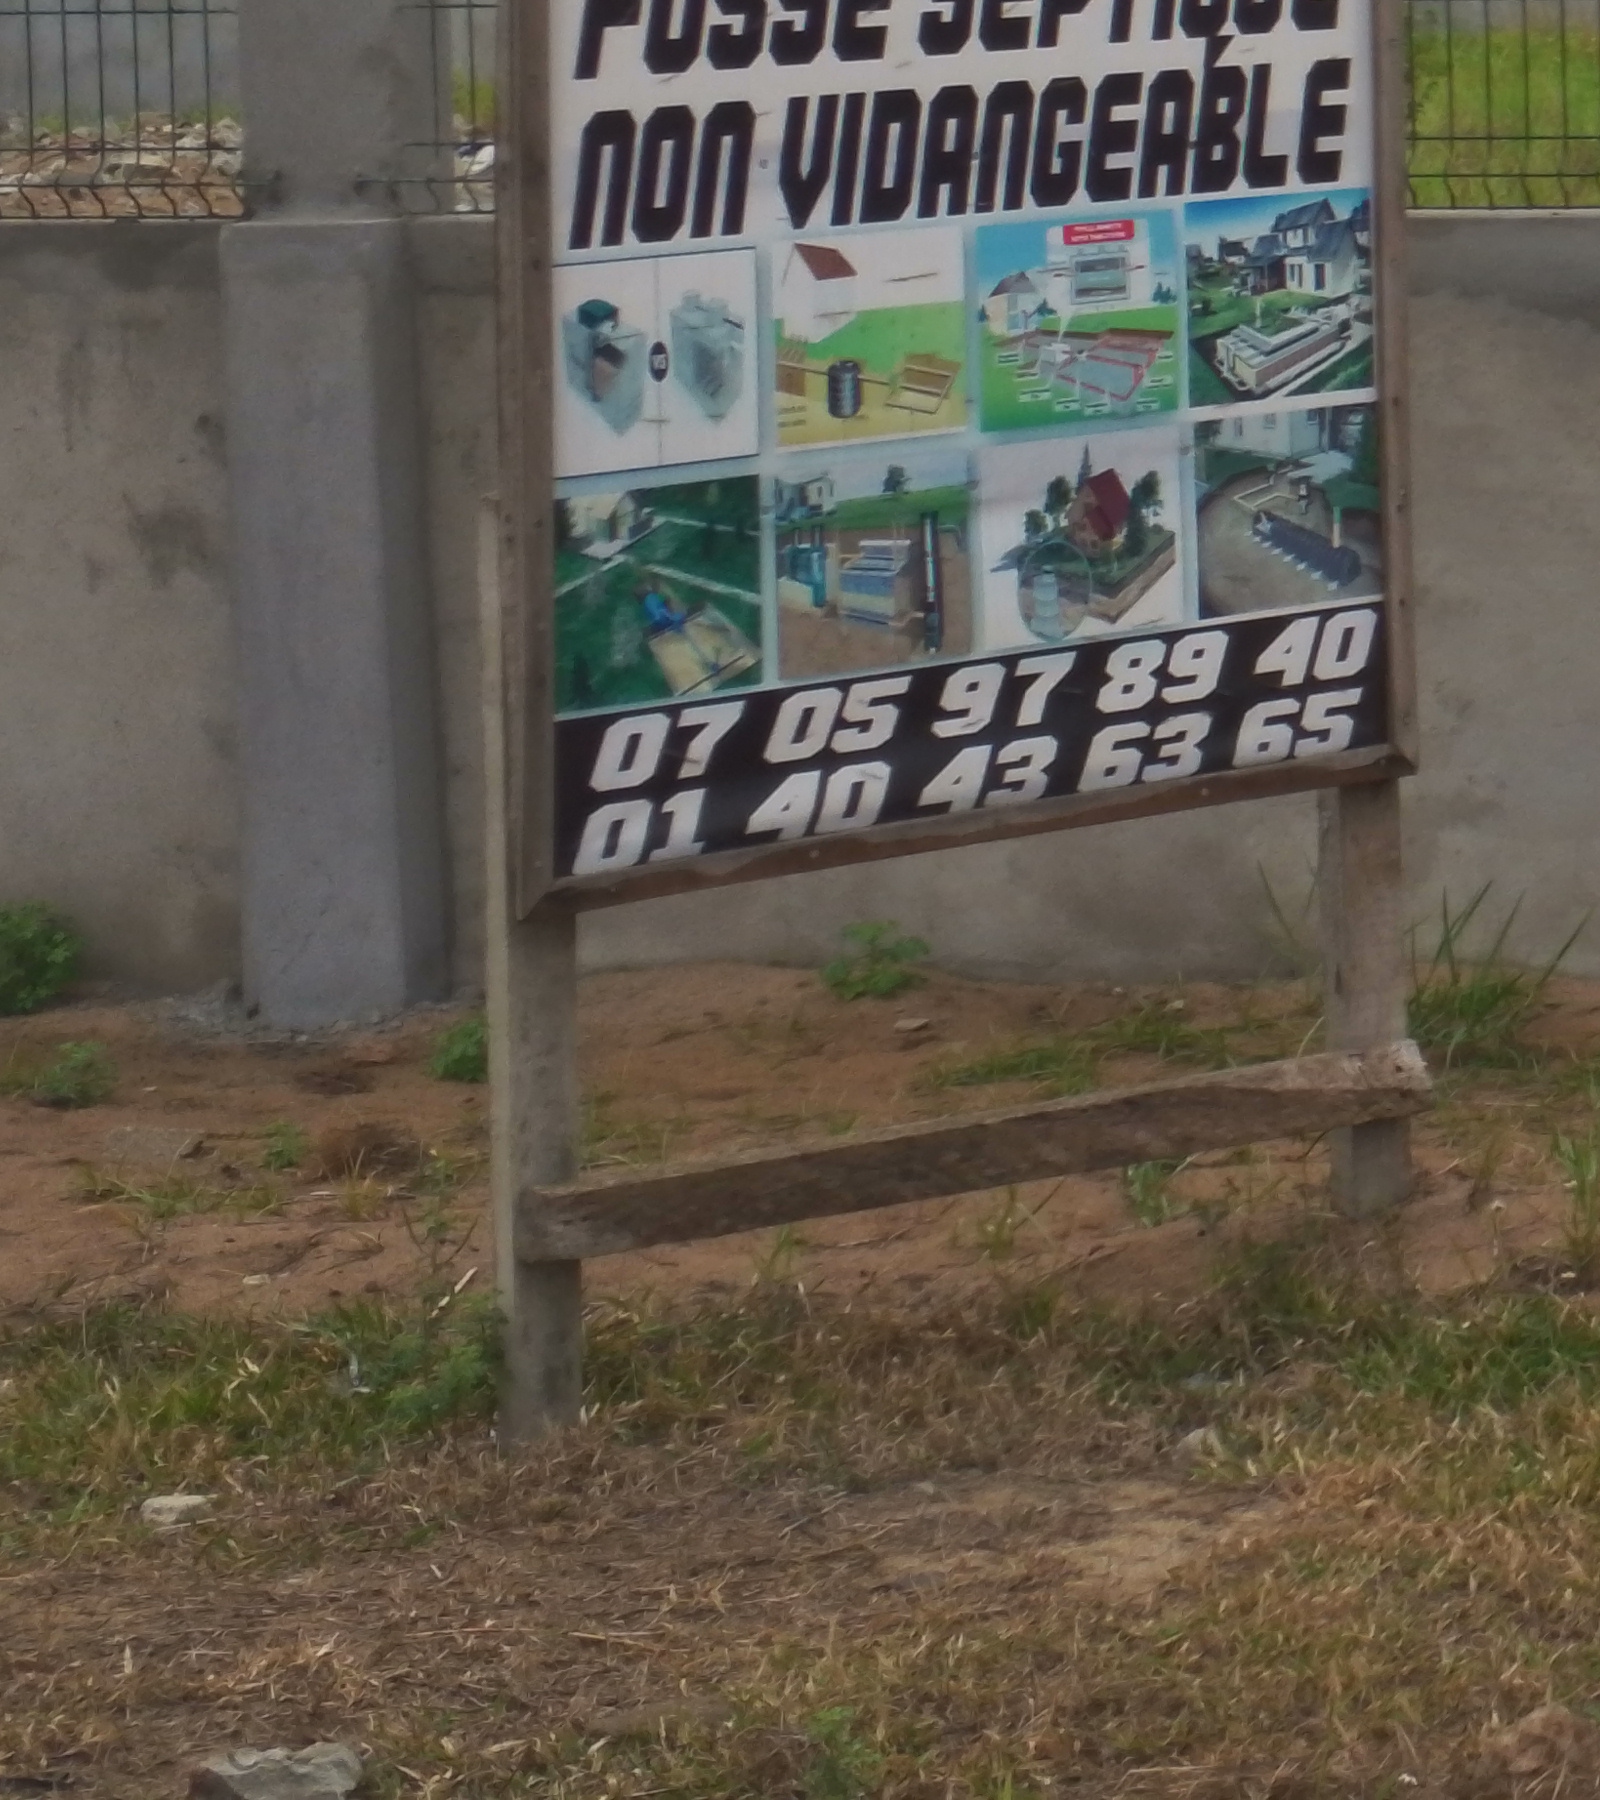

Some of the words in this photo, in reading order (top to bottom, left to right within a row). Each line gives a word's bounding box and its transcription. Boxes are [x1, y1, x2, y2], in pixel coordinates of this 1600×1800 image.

[568, 100, 757, 250] NON
[777, 57, 1351, 230] VIDANGEABLE
[571, 787, 709, 875] 01
[744, 761, 892, 840] 40
[917, 735, 1059, 813] 43
[1076, 711, 1214, 794] 63
[1231, 687, 1363, 768] 65
[589, 701, 745, 793] 07
[763, 675, 912, 764] 05
[931, 651, 1079, 739] 97
[1096, 630, 1231, 714] 89
[1255, 608, 1379, 687] 40
